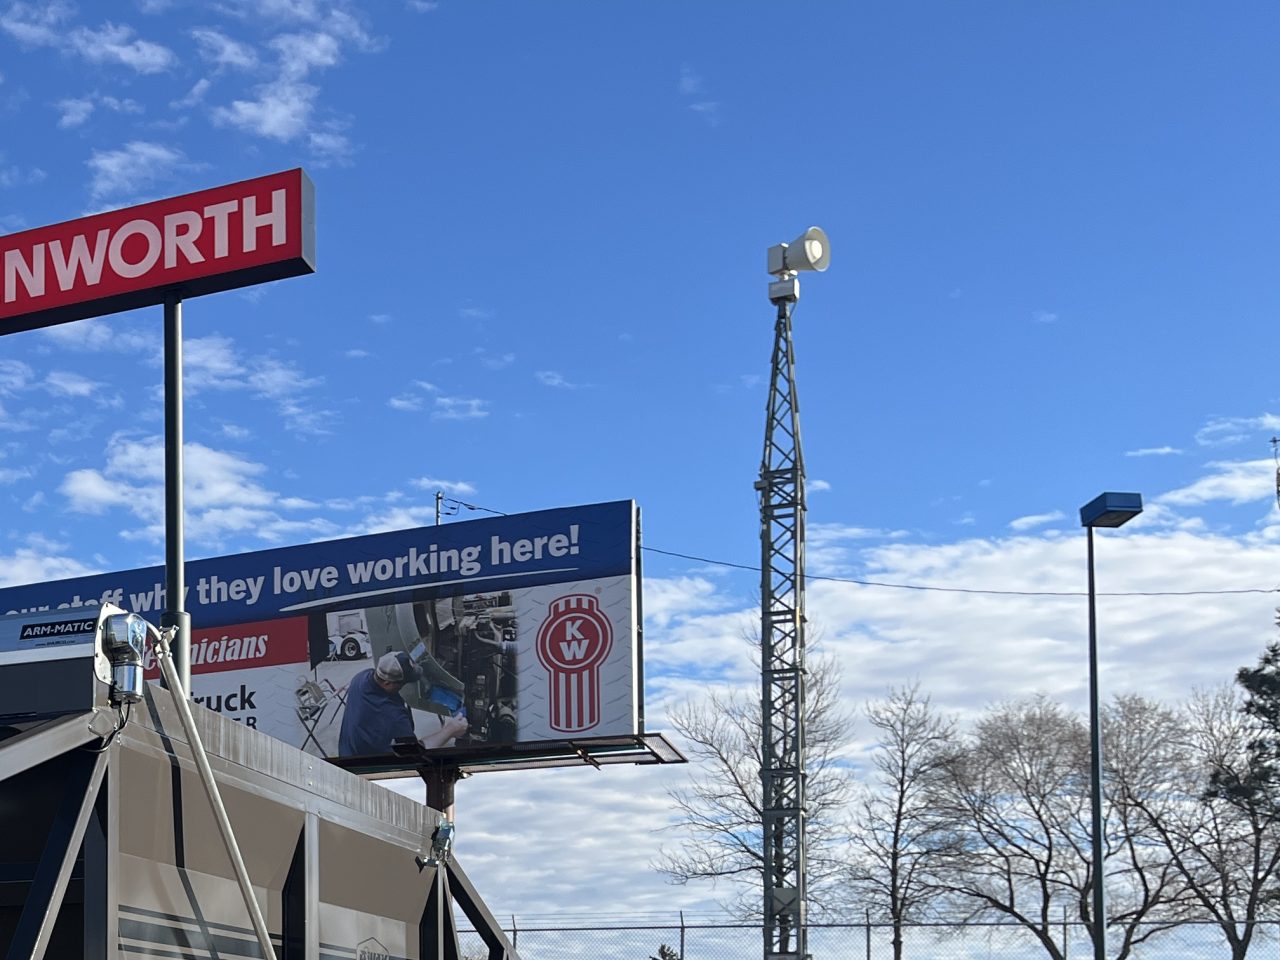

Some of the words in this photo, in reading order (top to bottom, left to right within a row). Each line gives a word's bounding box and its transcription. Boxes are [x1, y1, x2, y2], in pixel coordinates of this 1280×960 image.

[129, 583, 190, 613] wh
[196, 575, 265, 605] they
[273, 565, 340, 595] love
[346, 544, 482, 584] working
[490, 525, 580, 565] here!
[23, 621, 94, 637] ARM-MATIC
[565, 620, 585, 640] K
[559, 639, 590, 661] W
